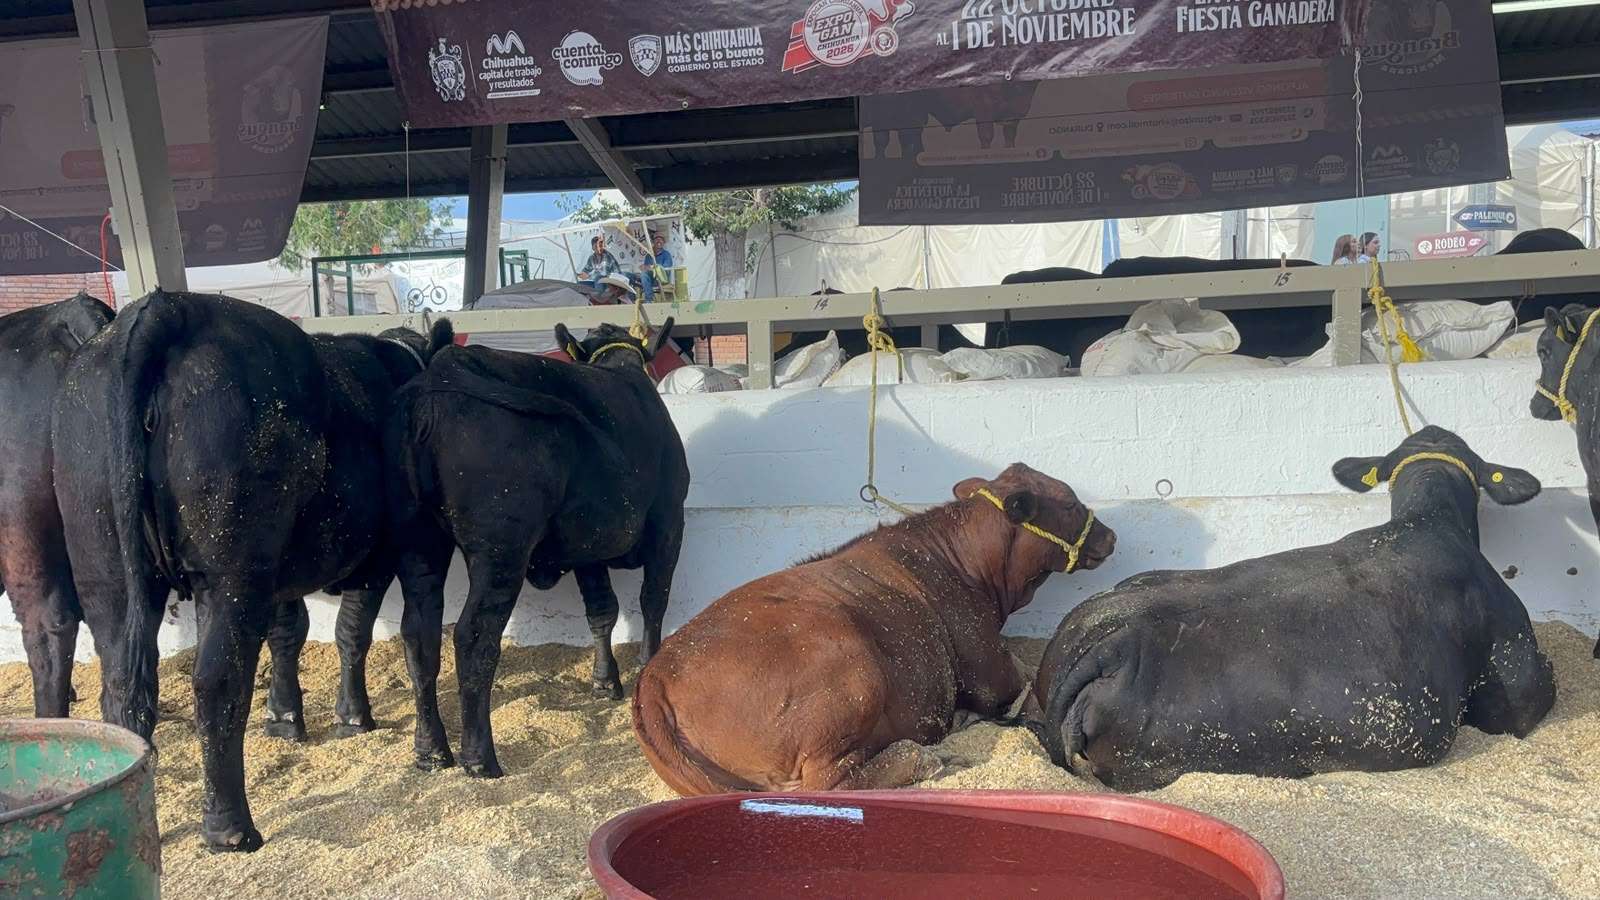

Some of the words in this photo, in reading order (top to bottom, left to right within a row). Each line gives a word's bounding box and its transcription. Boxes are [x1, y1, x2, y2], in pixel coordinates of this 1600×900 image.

[814, 11, 854, 30] EXPO
[1176, 5, 1242, 32] FIESTA
[1247, 0, 1335, 27] GANADERA
[819, 22, 854, 41] GAN
[936, 32, 950, 46] AL
[967, 21, 995, 49] DE
[1002, 8, 1136, 47] NOVIEMBRE
[664, 31, 692, 54] MÁS
[693, 26, 763, 51] CHIHUAHUA
[553, 43, 604, 58] cuenta
[666, 52, 692, 64] más
[693, 51, 709, 61] de
[711, 50, 723, 60] lo
[725, 47, 764, 59] bueno
[482, 55, 534, 69] Chihuahua
[563, 54, 622, 68] conmigo
[668, 62, 711, 73] GOBIERNO
[713, 61, 729, 69] DEL
[731, 57, 765, 68] ESTADO
[479, 69, 504, 81] capital
[504, 68, 514, 78] de
[515, 66, 542, 78] trabajo
[489, 82, 494, 91] y
[494, 78, 534, 89] resultados
[1434, 237, 1466, 250] RODEO
